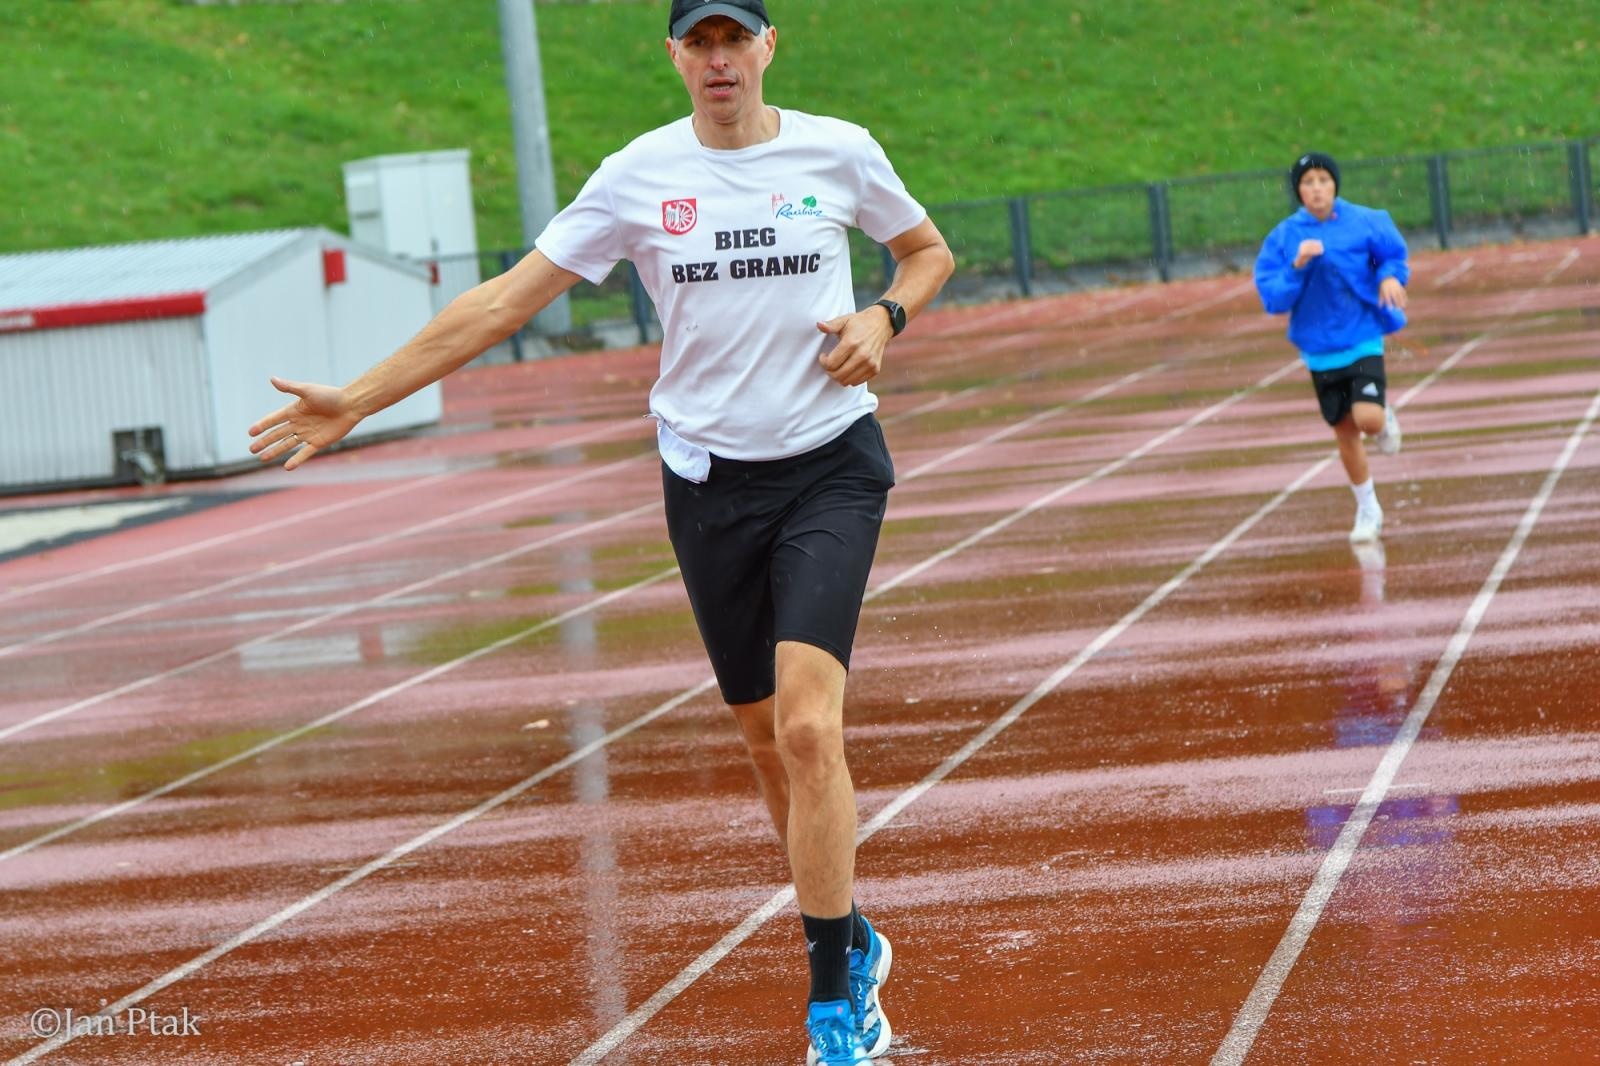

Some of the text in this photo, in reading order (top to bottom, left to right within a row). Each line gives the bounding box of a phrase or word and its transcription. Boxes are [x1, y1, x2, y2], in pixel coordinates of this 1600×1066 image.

[715, 227, 776, 251] BIEG
[672, 253, 821, 284] BEZ GRANIC
